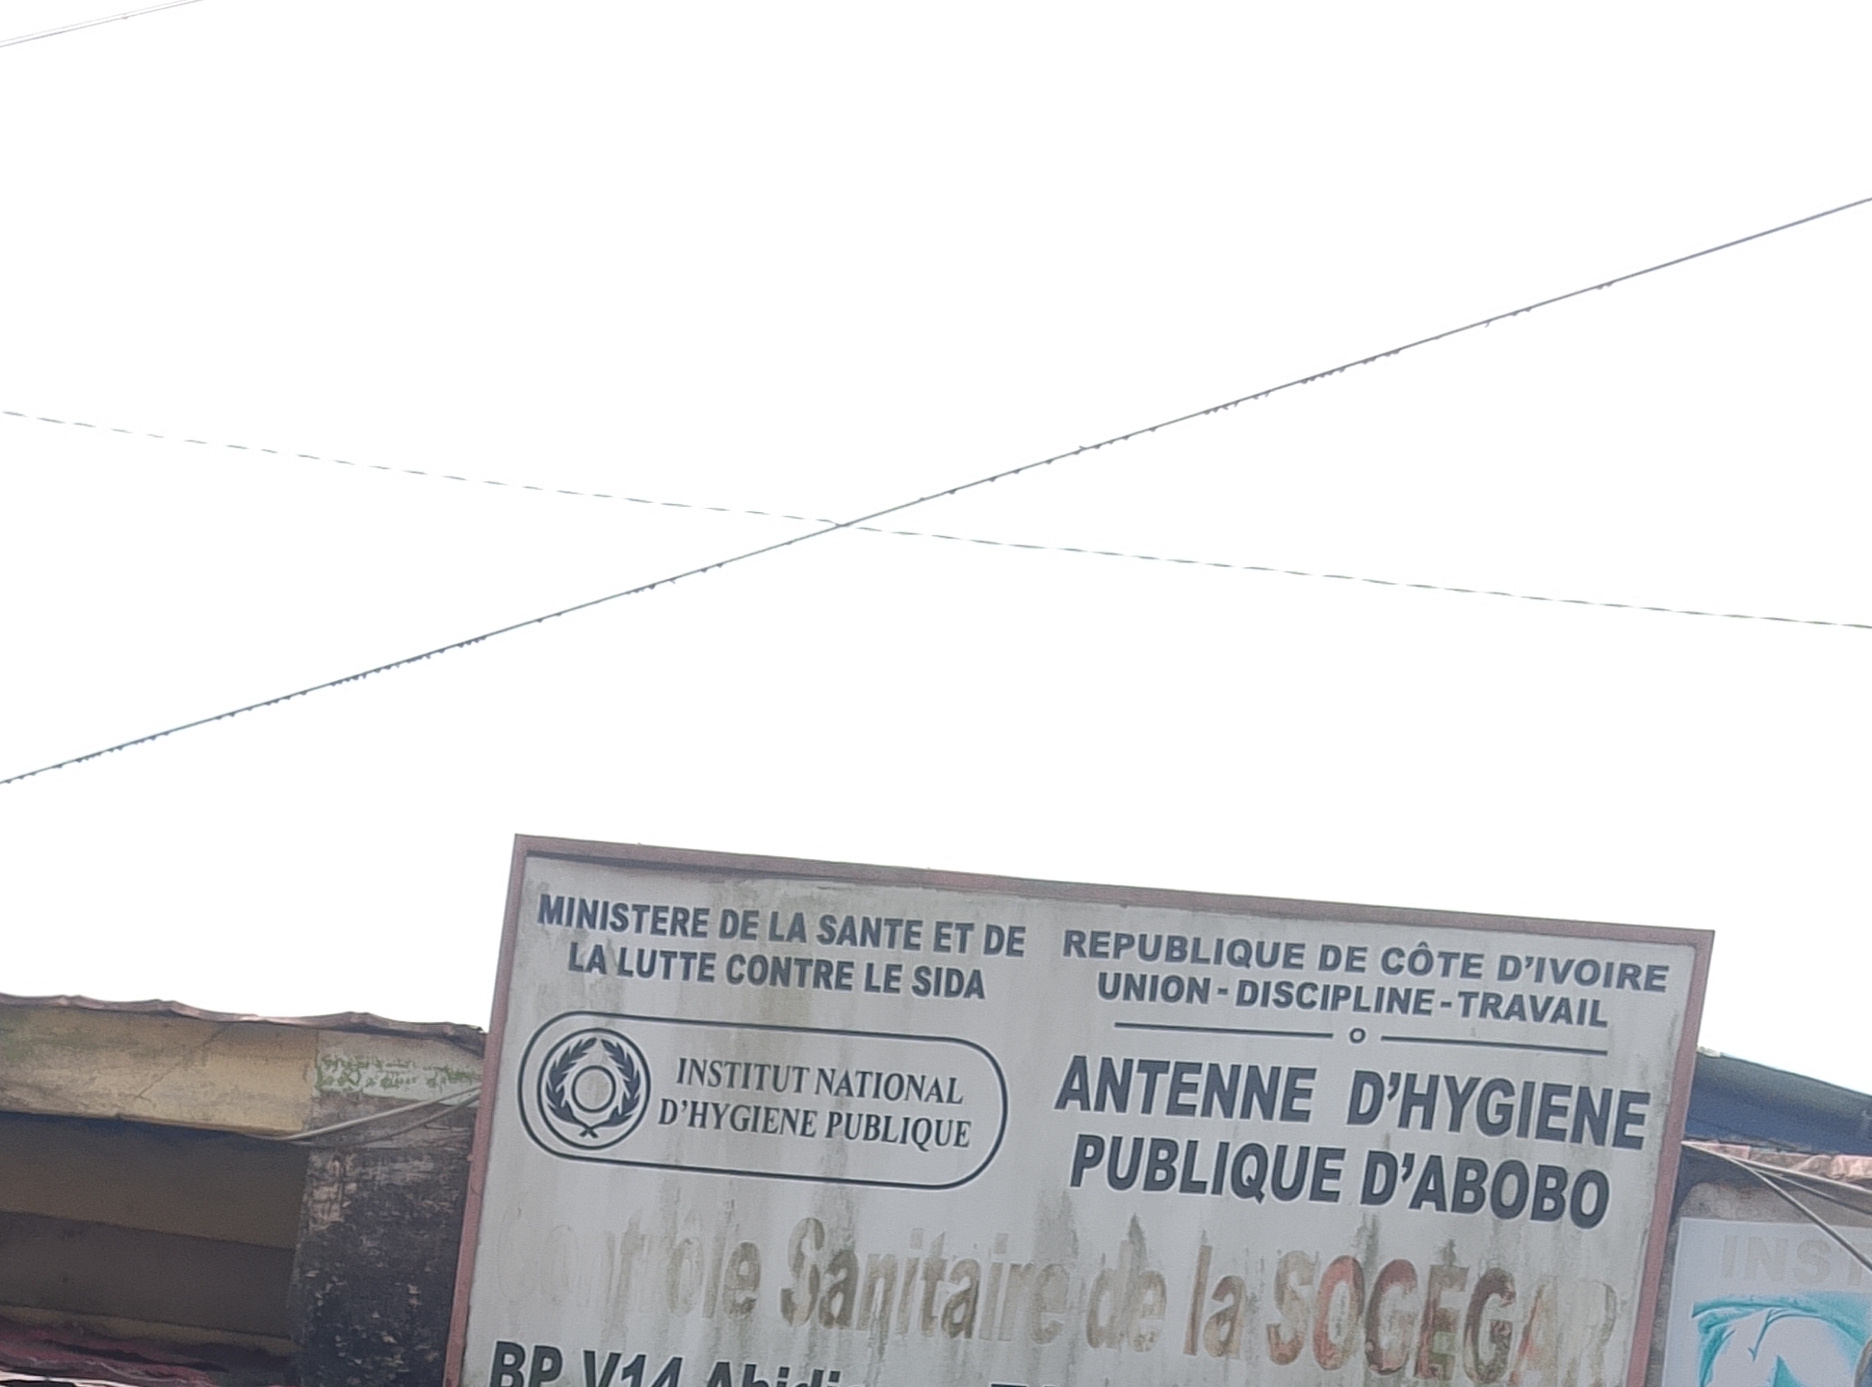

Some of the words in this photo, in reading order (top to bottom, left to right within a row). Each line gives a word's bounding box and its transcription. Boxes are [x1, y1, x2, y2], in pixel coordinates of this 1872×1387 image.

[536, 894, 709, 939] MINISTERE
[718, 908, 760, 942] DE
[768, 911, 807, 944] LA
[816, 914, 922, 952] SANTE
[933, 919, 975, 955] ET
[983, 924, 1026, 958] DE
[1062, 928, 1307, 973] REPUBLIQUE
[1318, 942, 1368, 975] DE
[1380, 941, 1485, 980] CÔTE
[567, 942, 610, 975] LA
[616, 945, 716, 983] LUTTE
[727, 953, 855, 992] CONTRE
[864, 960, 902, 994] LE
[911, 963, 987, 1000] SIDA
[1097, 971, 1212, 1006] UNION
[1235, 978, 1434, 1018] DISCIPLINE
[1457, 990, 1609, 1029] TRAVAIL
[676, 1056, 810, 1094] INSTITUT
[814, 1065, 964, 1105] NATIONAL
[1054, 1054, 1318, 1124] ANTENNE
[825, 1110, 972, 1153] PUBLIQUE
[1069, 1133, 1346, 1206] PUBLIQUE
[779, 1216, 1068, 1345] Sanitaire
[1085, 1238, 1168, 1354] de
[1183, 1244, 1246, 1359] la
